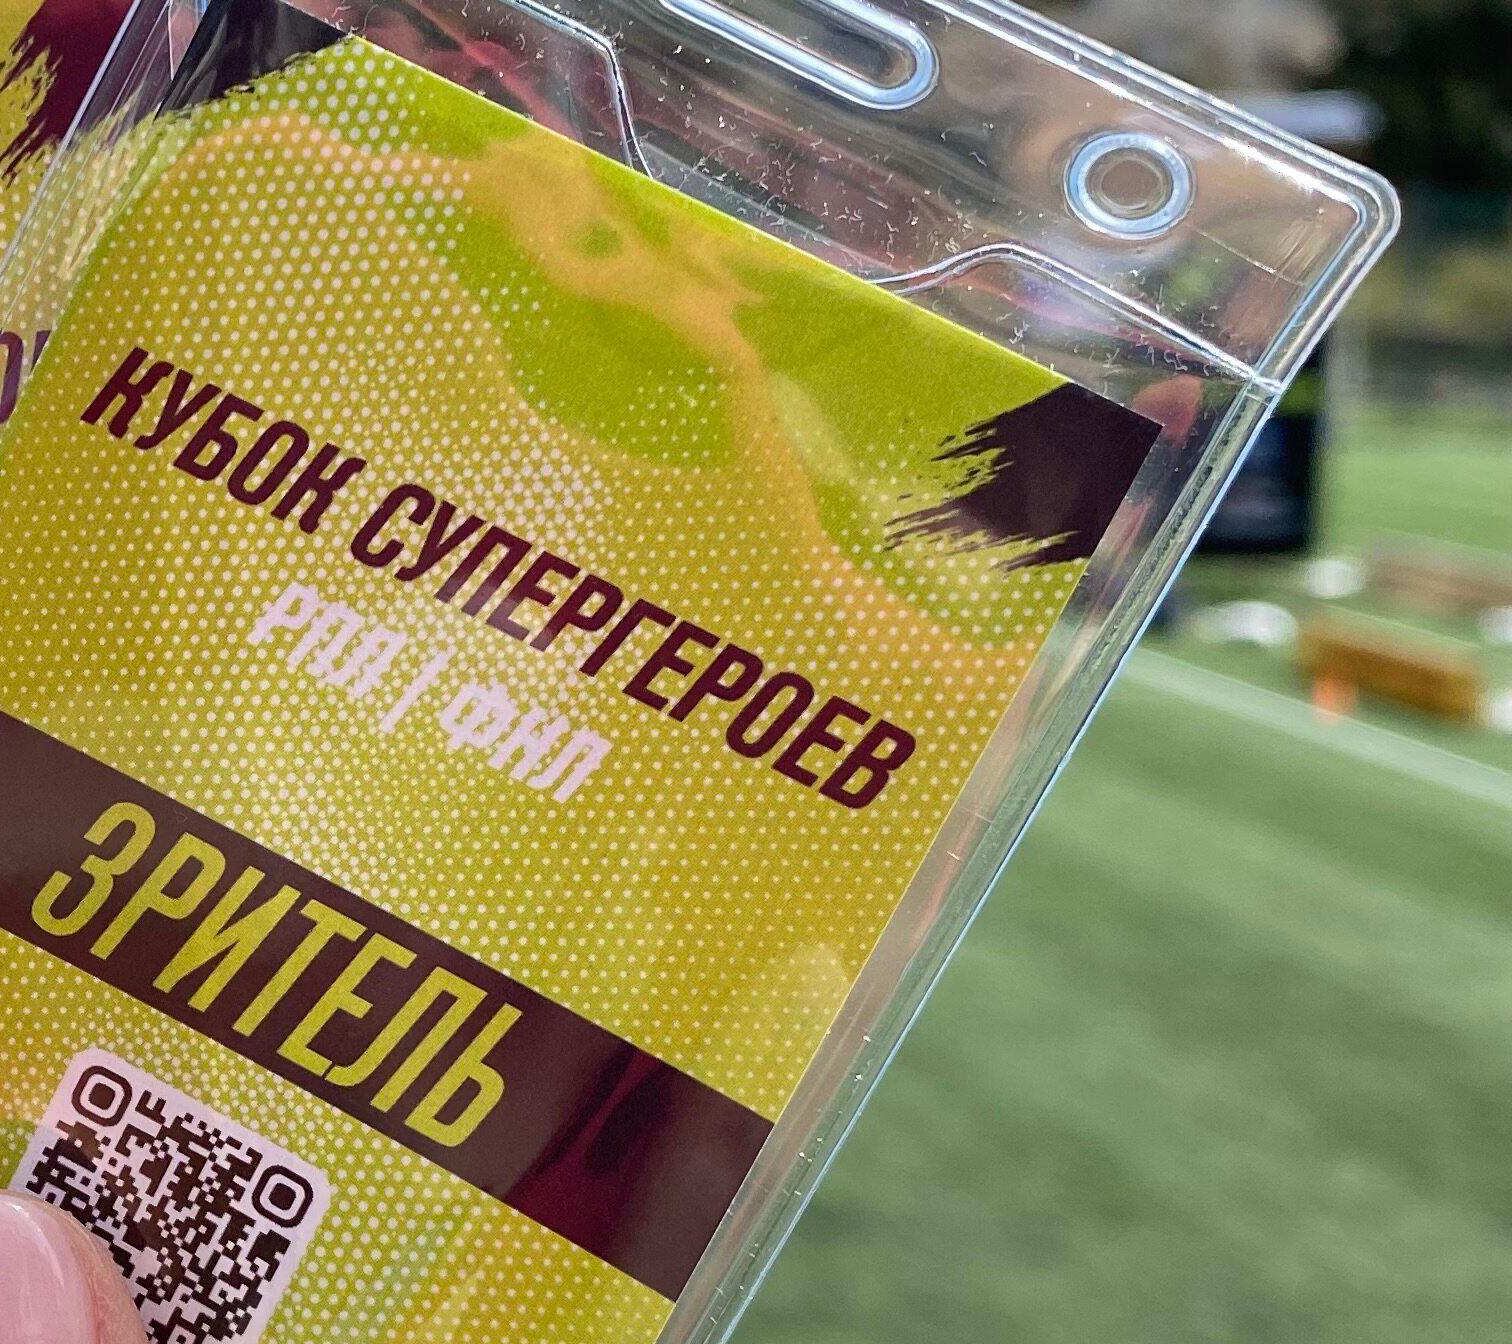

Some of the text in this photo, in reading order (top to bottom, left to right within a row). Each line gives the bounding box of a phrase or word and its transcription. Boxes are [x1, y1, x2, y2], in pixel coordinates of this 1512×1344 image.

[80, 347, 917, 810] КУБОК СУПЕРГЕРОЕВ
[247, 582, 408, 699] РПЛ
[439, 677, 613, 804] ФНЛ
[31, 802, 522, 1148] ЗРИТЕЛЬ
